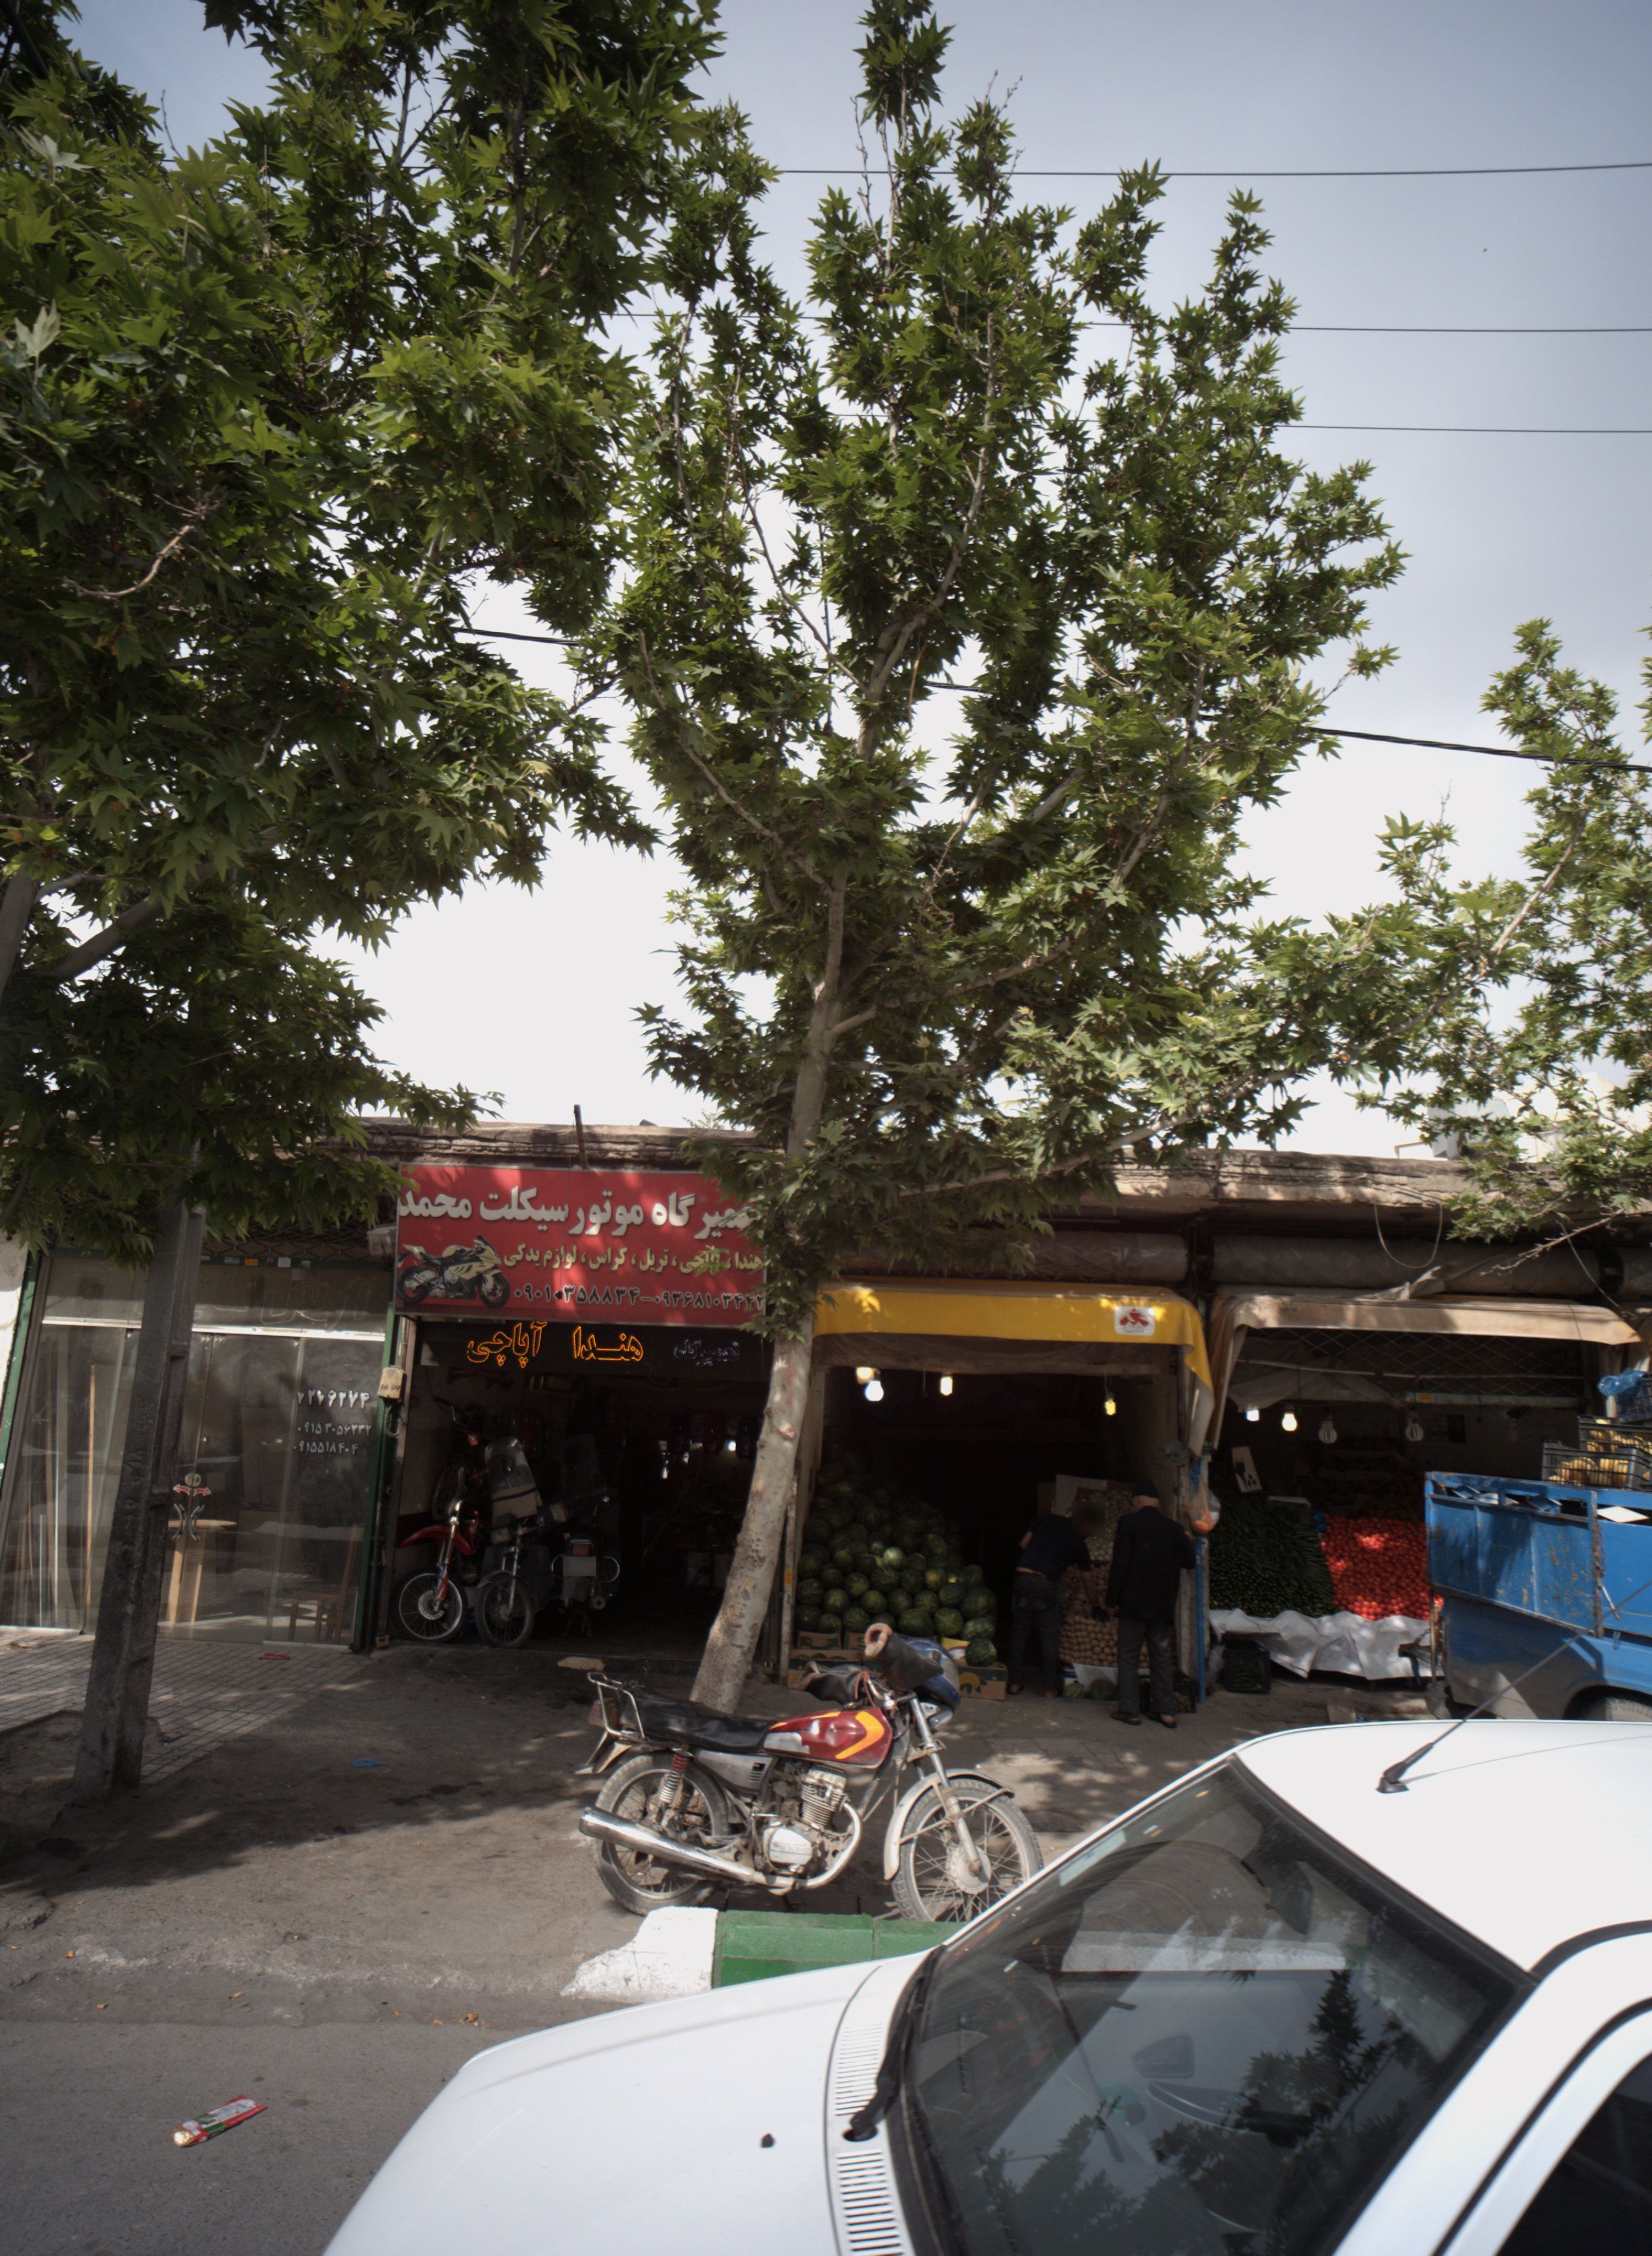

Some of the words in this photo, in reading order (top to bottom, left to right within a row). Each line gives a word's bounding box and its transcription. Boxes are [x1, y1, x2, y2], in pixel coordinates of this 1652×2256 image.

[399, 1190, 472, 1218] محمد
[480, 1185, 569, 1231] سیکلت
[568, 1190, 644, 1235] موتور
[504, 1243, 540, 1266] یدکی
[544, 1244, 578, 1269] لوازم
[467, 1321, 548, 1369] آپاچی
[572, 1325, 644, 1362] هندا
